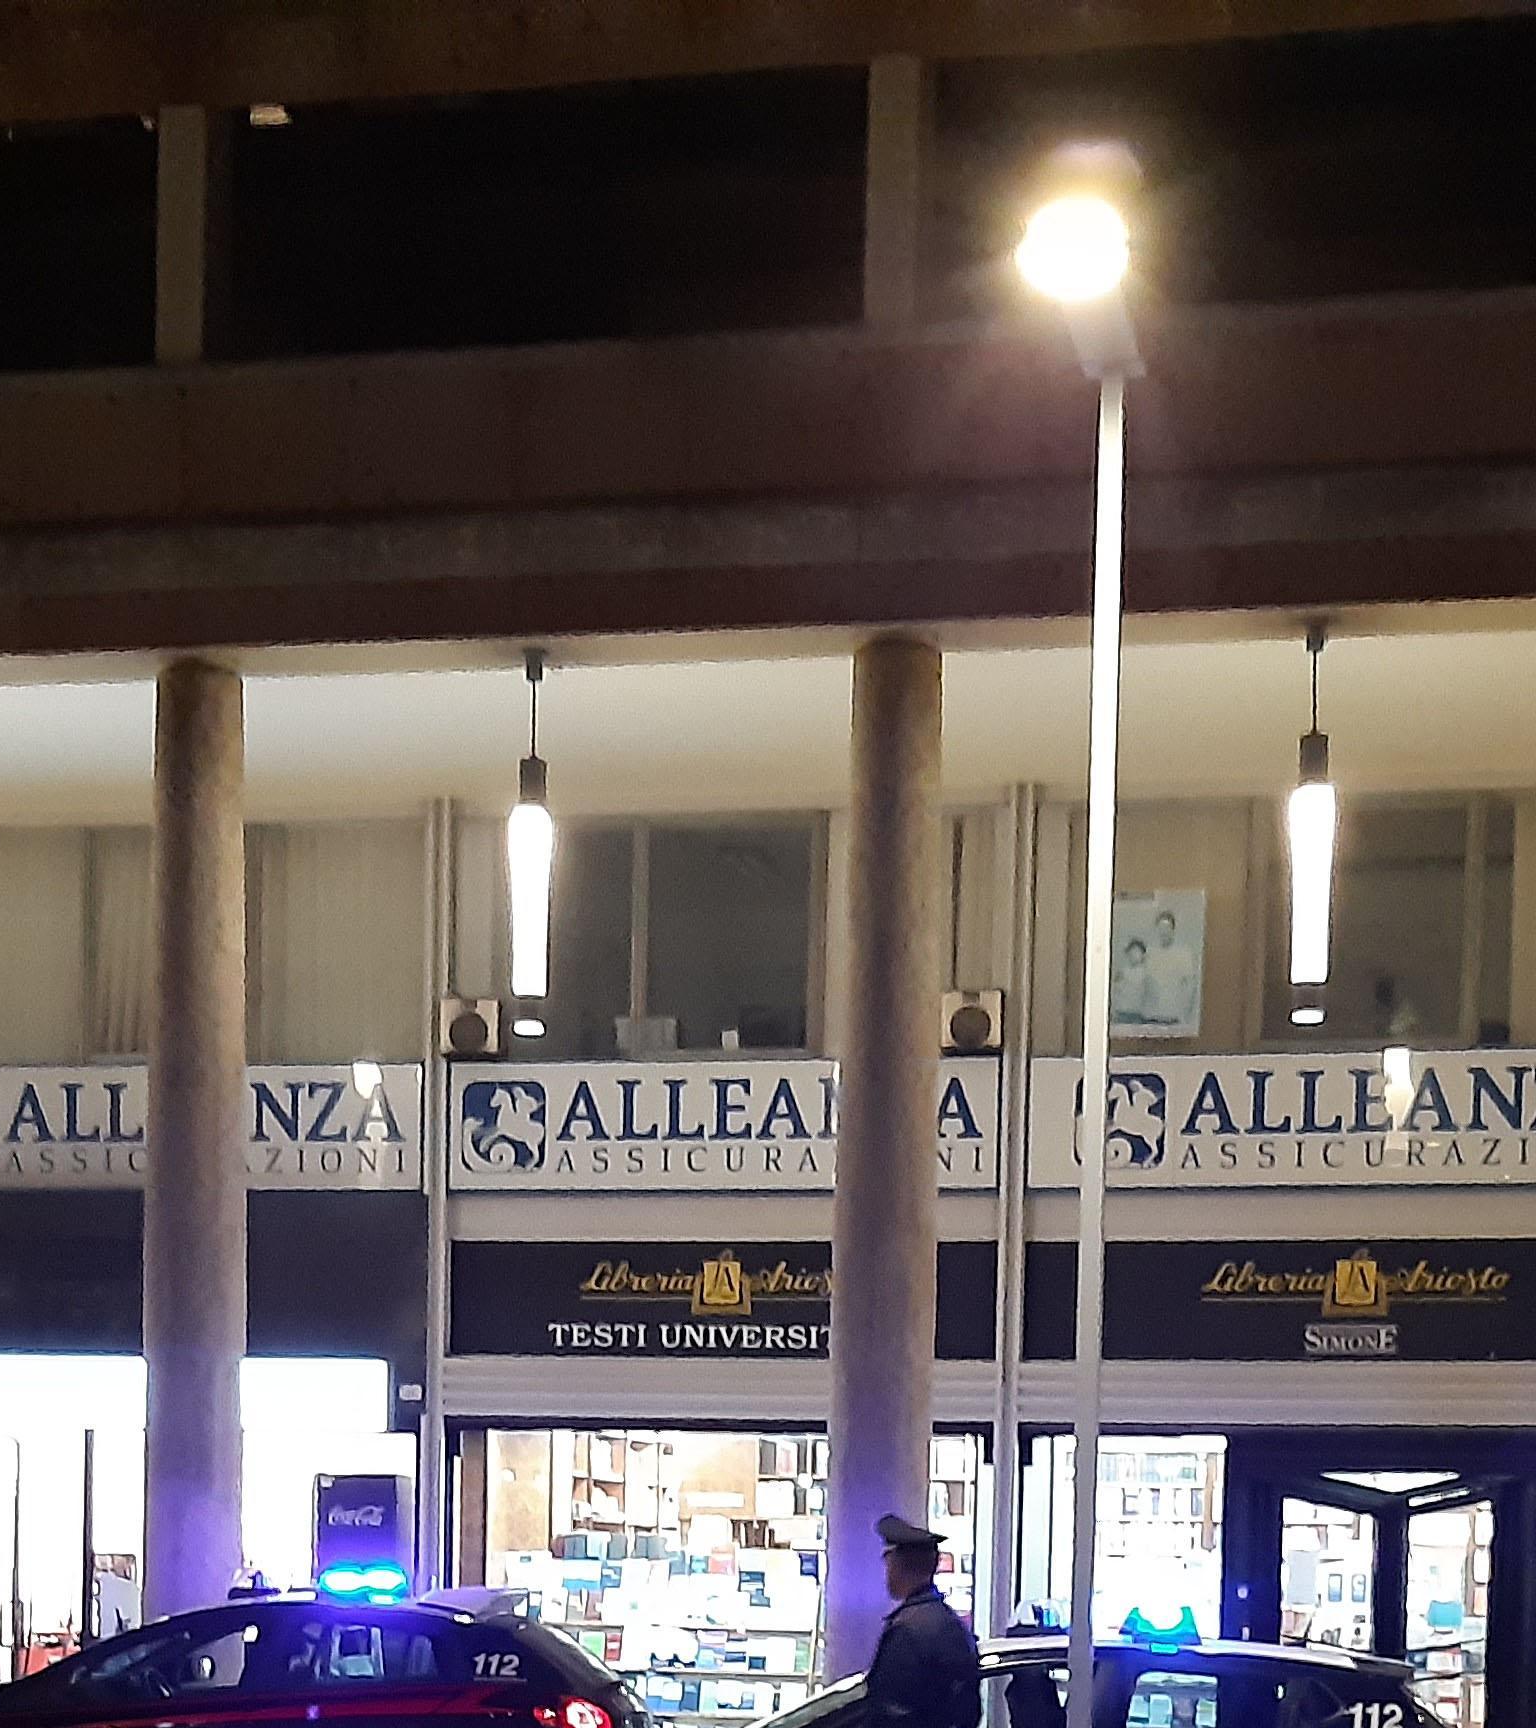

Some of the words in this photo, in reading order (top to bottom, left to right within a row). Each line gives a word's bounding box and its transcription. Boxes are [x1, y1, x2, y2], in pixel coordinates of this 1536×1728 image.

[4, 1082, 406, 1142] ALLNZA
[556, 1078, 984, 1140] ALLEAA
[3, 1148, 405, 1174] ASSICZIONI
[557, 1146, 983, 1173] ASSICURANI
[580, 1259, 696, 1293] Libreria
[1201, 1259, 1324, 1294] Libreria
[548, 1323, 646, 1348] TESTI
[472, 1653, 520, 1676] 112
